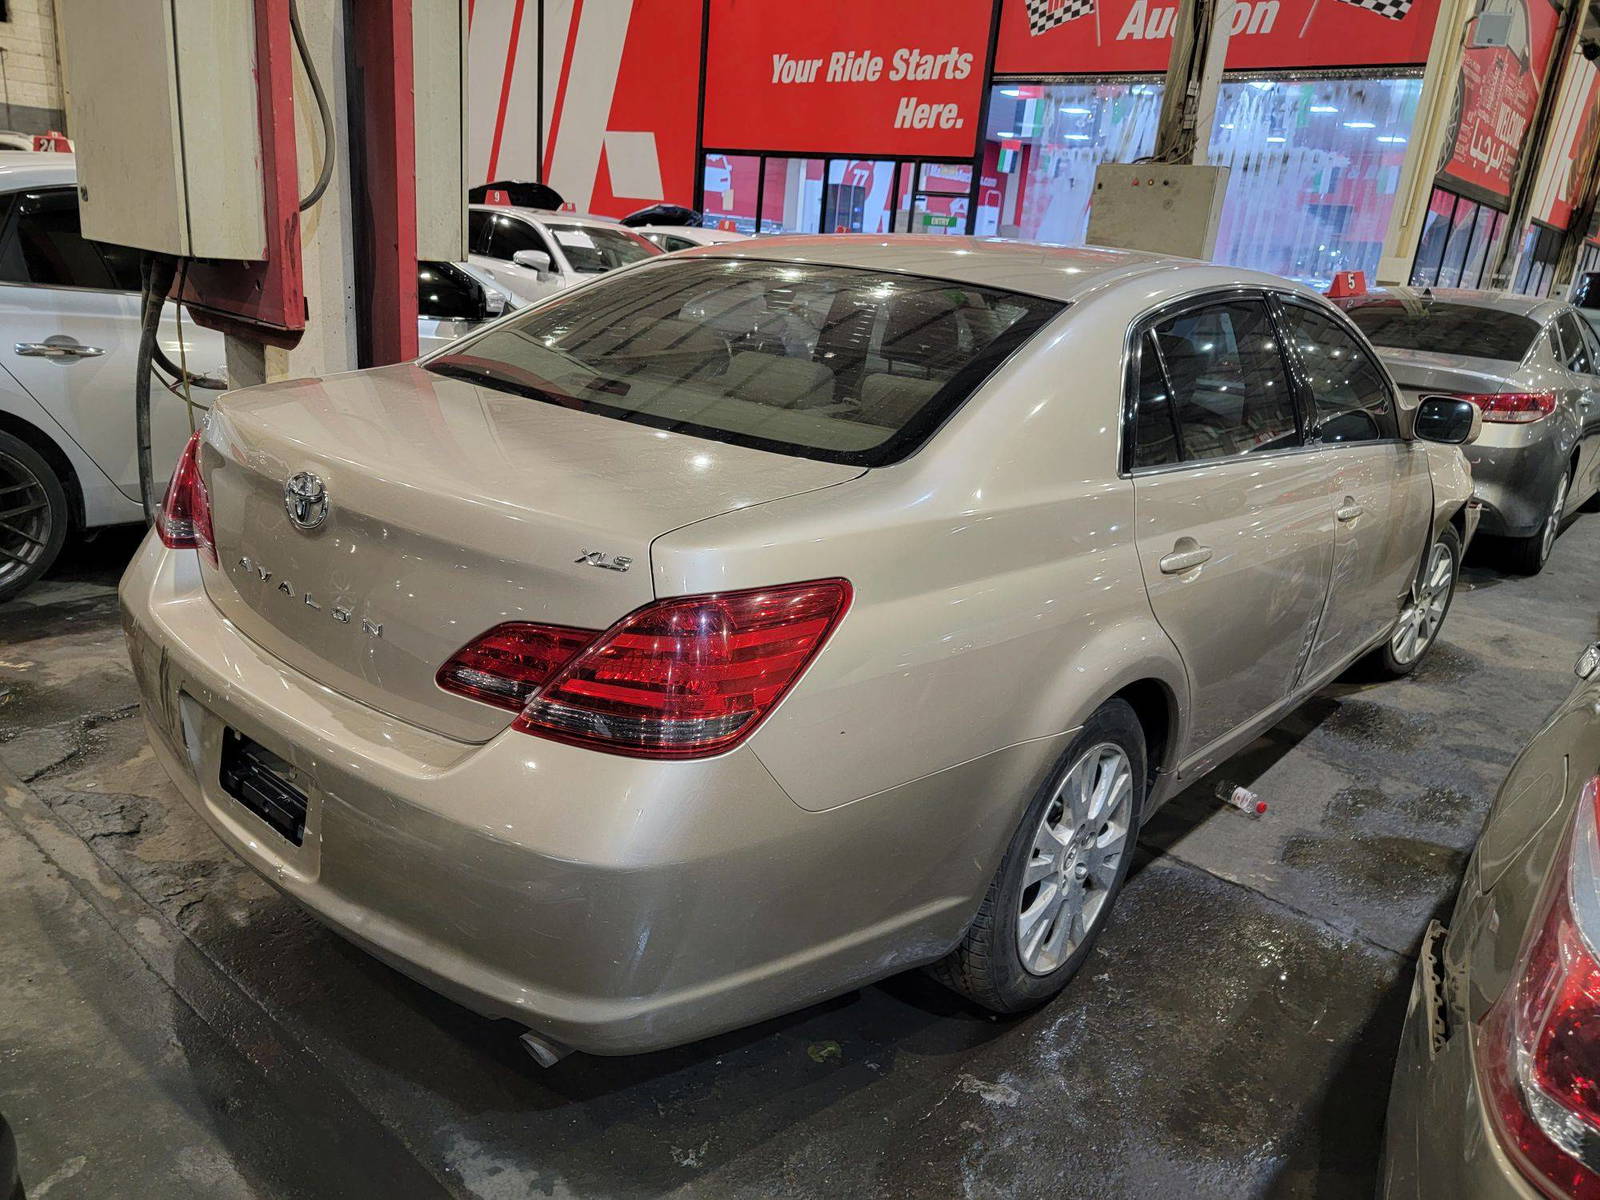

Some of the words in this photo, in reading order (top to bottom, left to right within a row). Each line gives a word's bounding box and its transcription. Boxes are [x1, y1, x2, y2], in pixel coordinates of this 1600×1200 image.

[1115, 0, 1280, 41] Auon
[771, 54, 823, 84] Your
[826, 50, 883, 83] Ride
[889, 47, 974, 81] Starts
[893, 97, 964, 129] Here.
[1494, 101, 1526, 151] WELCOME
[40, 138, 56, 153] 24
[1469, 117, 1506, 174] مرحبا
[494, 191, 501, 202] 9
[930, 217, 950, 226] ENTRY
[1346, 272, 1356, 290] 5
[574, 547, 634, 573] XLS
[238, 556, 384, 639] AVALON
